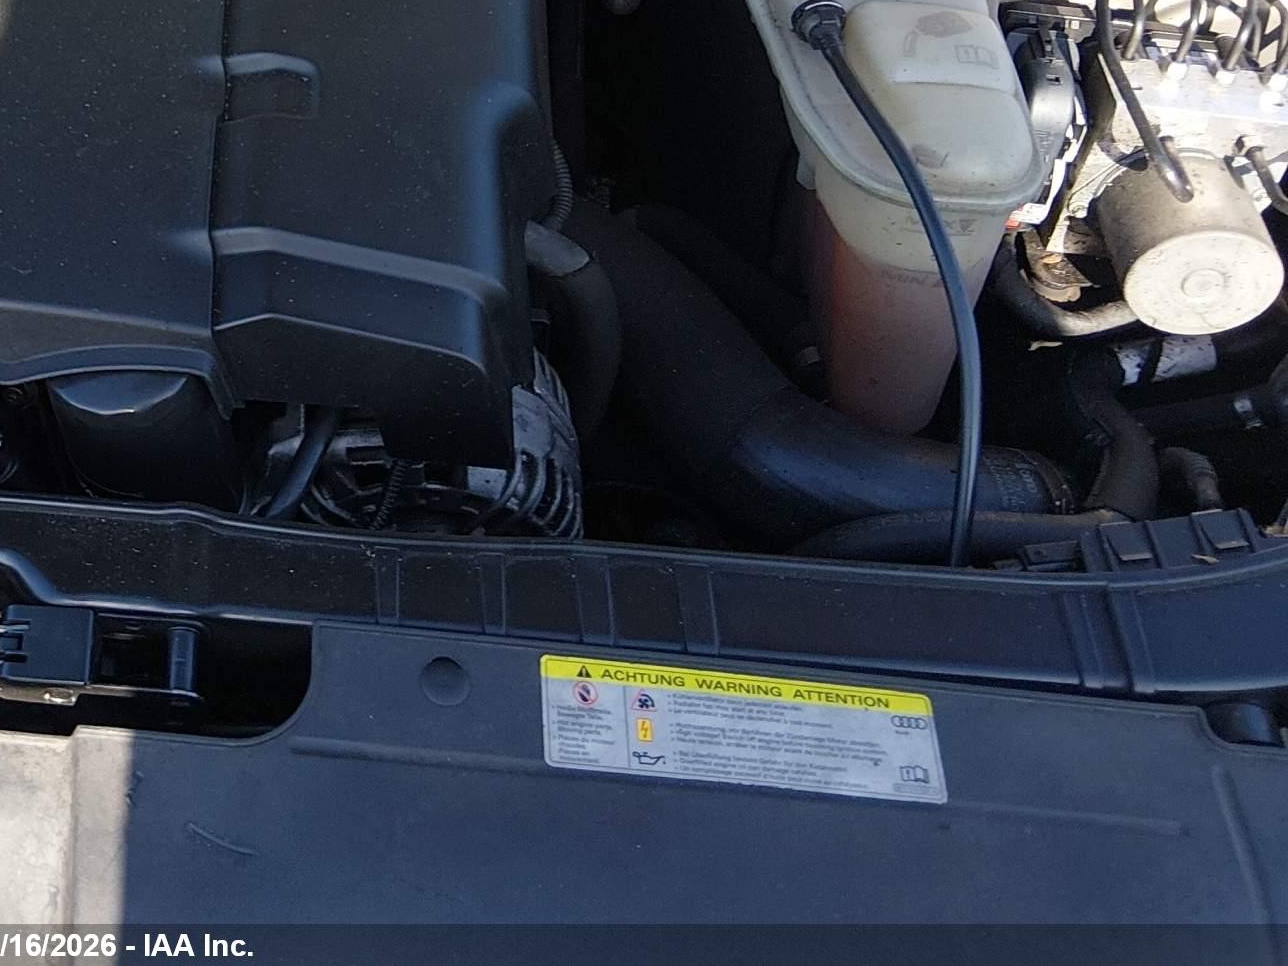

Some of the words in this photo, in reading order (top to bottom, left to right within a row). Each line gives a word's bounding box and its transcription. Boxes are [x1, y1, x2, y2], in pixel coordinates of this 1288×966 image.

[600, 668, 686, 687] ACHTUNG
[695, 677, 782, 698] WARNING
[792, 689, 890, 709] ATTENTION
